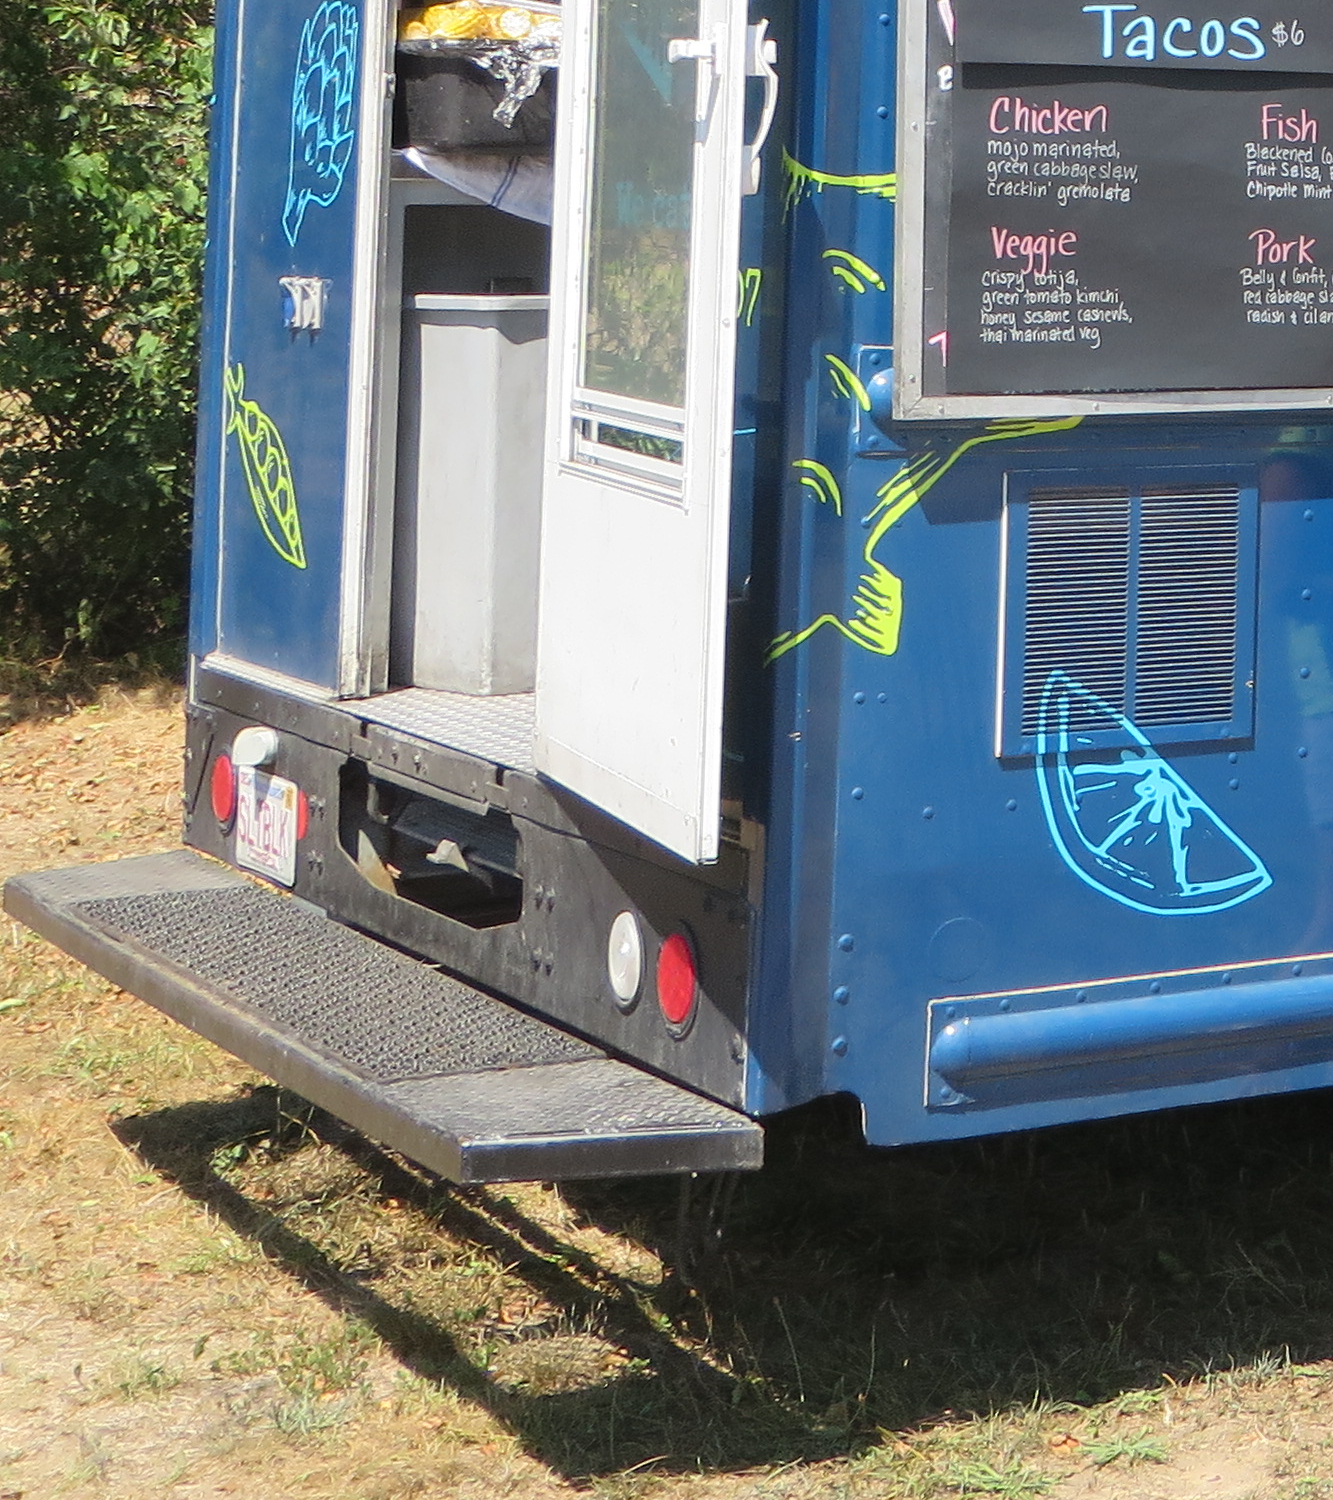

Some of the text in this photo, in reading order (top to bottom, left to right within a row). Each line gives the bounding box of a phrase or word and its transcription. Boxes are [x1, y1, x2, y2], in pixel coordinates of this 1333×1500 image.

[1082, 3, 1304, 61] Tacos $6
[989, 96, 1108, 135] Chicken
[1262, 103, 1317, 143] Fish
[987, 138, 1121, 161] mojo marinated,
[1245, 142, 1313, 163] Blackened
[987, 160, 1139, 184] green cabbage slaw,
[1246, 161, 1277, 177] Fruit
[1281, 163, 1322, 182] Salsa,
[1057, 183, 1131, 207] gremolata
[1246, 181, 1298, 201] Chipotle
[991, 226, 1078, 275] Veggie
[1248, 228, 1316, 265] Pork
[981, 269, 1079, 293] crispy cotija,
[1239, 267, 1275, 292] Belly
[982, 290, 1020, 312] green
[1024, 288, 1072, 305] tomato
[1243, 290, 1262, 305] red
[1265, 289, 1315, 310] cabbage
[980, 308, 1016, 329] honey
[1024, 309, 1071, 325] sesame
[1247, 308, 1285, 324] radish
[980, 326, 1101, 349] thai marinated veg
